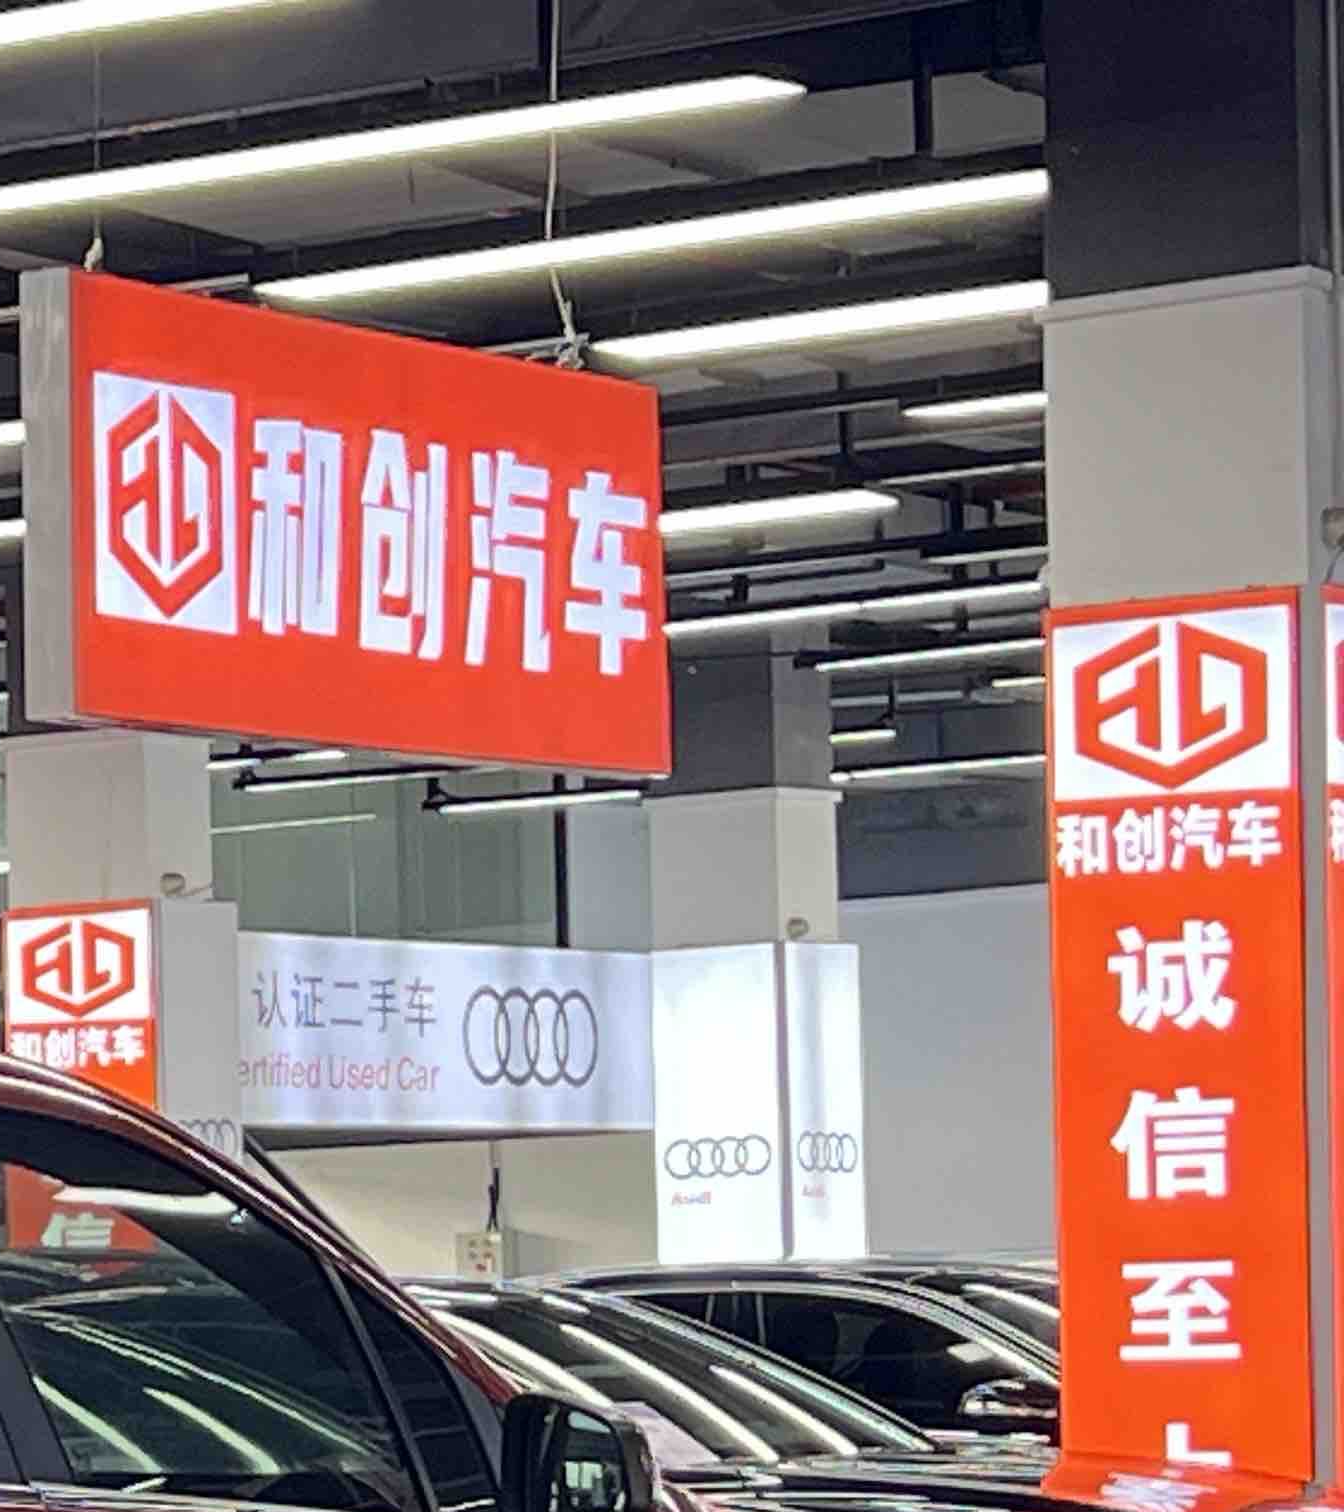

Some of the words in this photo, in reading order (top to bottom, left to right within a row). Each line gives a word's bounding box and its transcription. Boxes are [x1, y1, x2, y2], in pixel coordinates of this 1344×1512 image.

[248, 418, 647, 676] 和创汽车
[1055, 800, 1282, 878] 和创汽车
[252, 970, 438, 1038] 认证二手车
[329, 1055, 389, 1090] Used
[397, 1058, 441, 1091] Car
